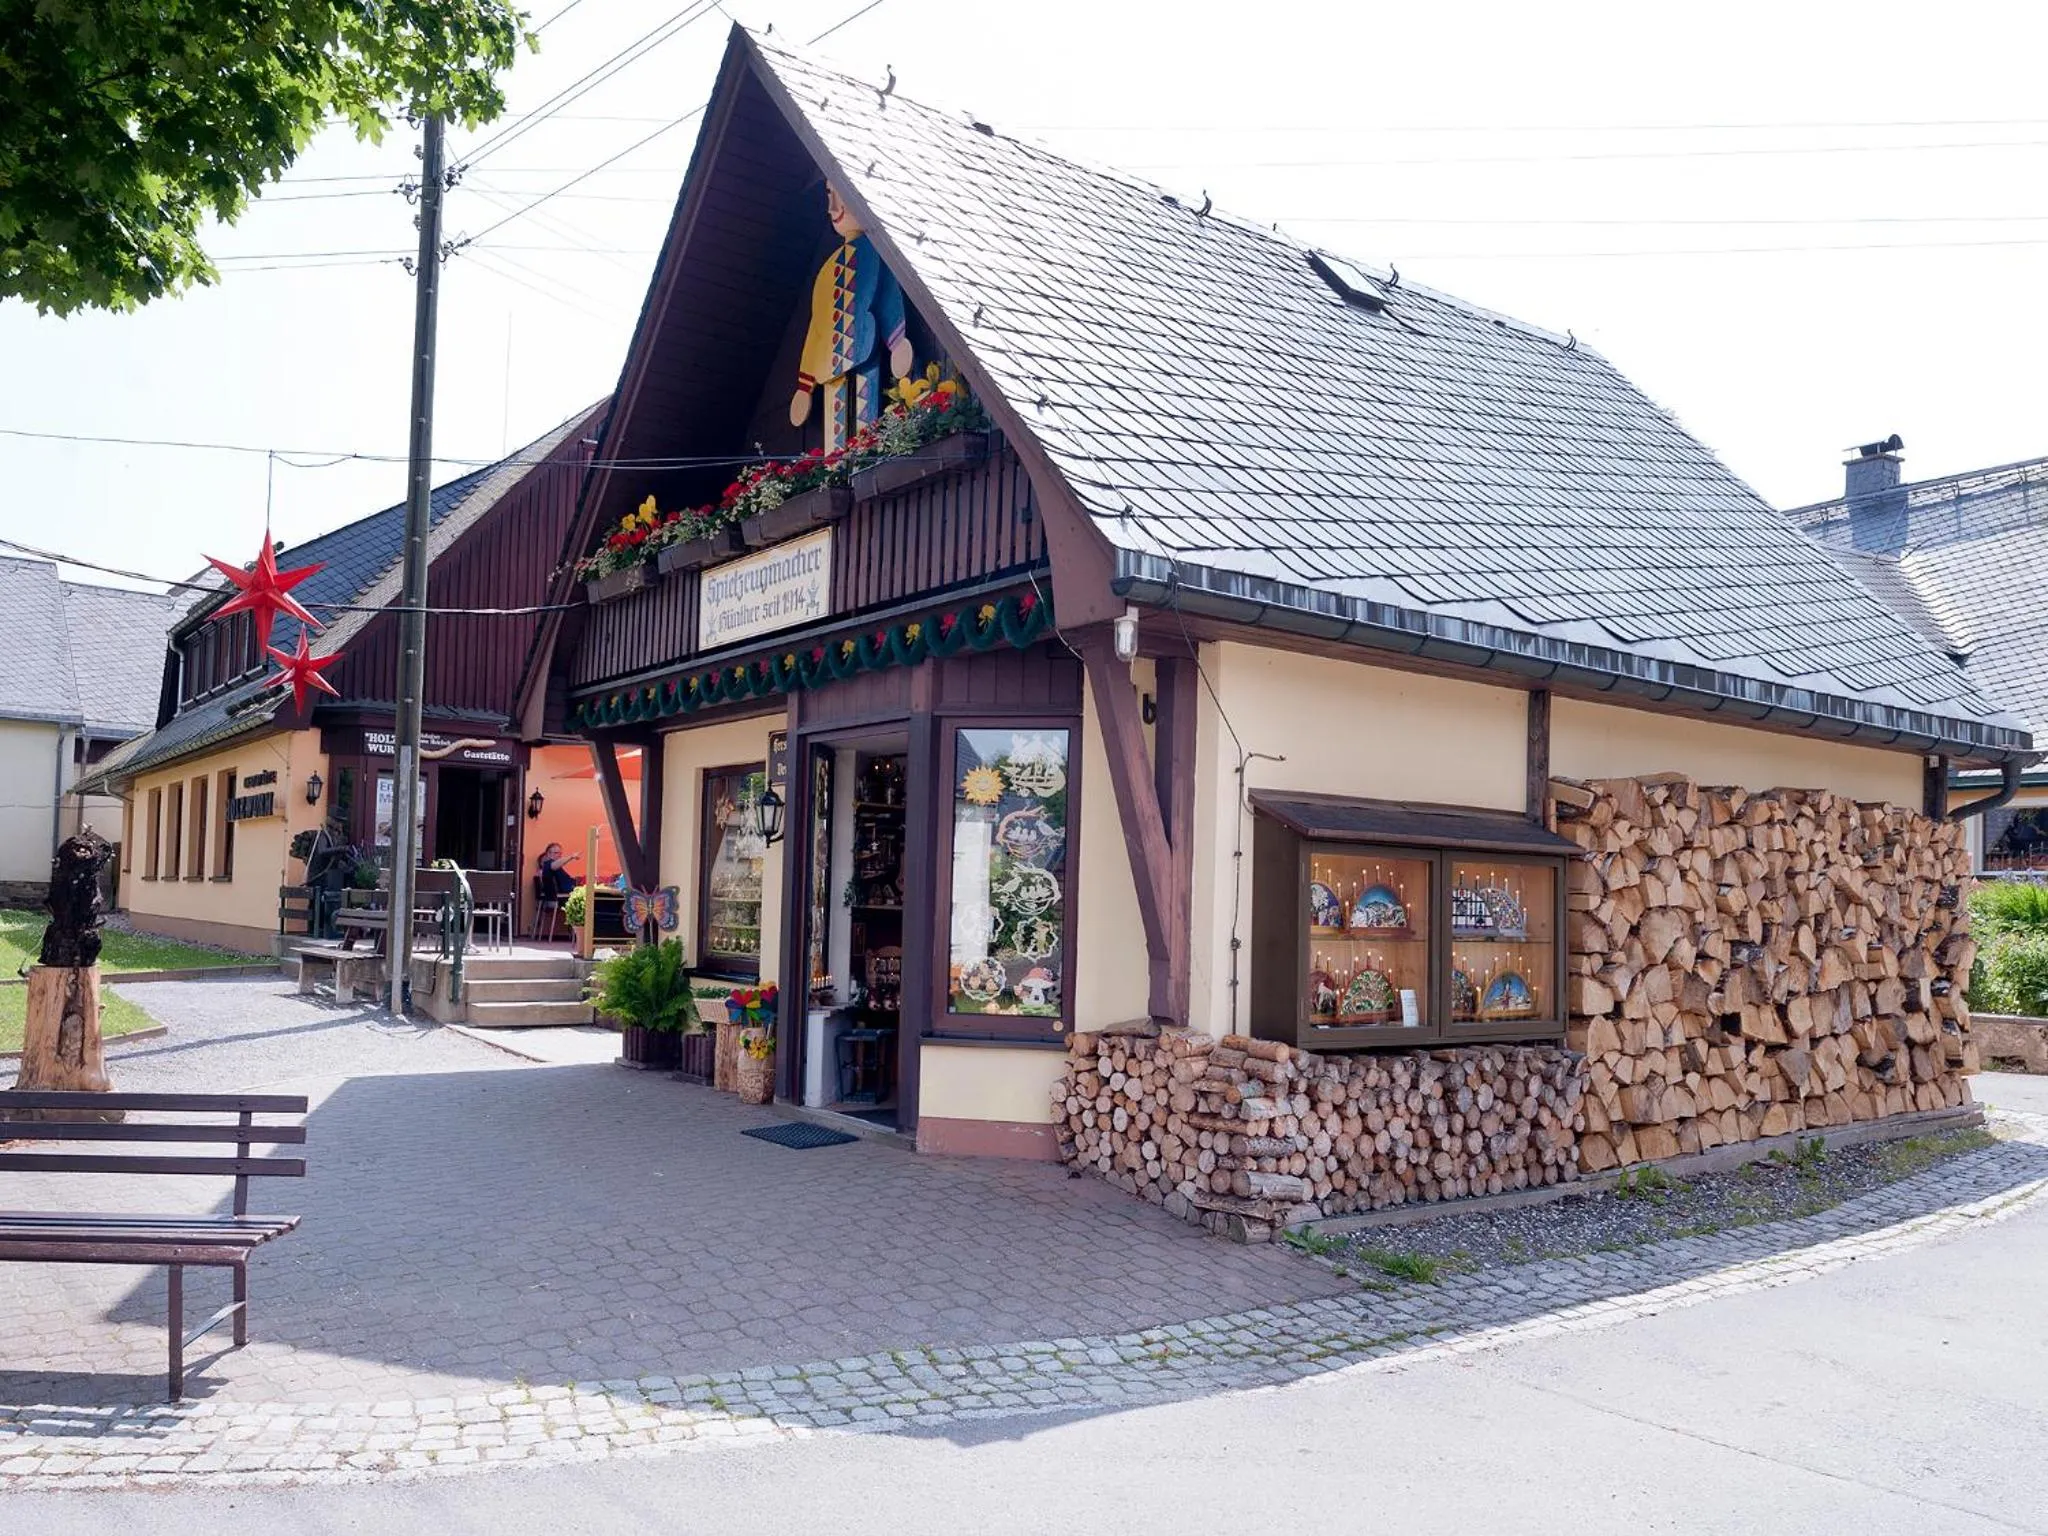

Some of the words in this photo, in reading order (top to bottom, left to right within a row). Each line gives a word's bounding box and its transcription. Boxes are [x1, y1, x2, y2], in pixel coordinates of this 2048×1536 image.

[708, 548, 821, 606] Spielzeugmacher
[762, 595, 780, 619] seit
[367, 743, 396, 754] WUR
[463, 750, 510, 761] Gaststätte
